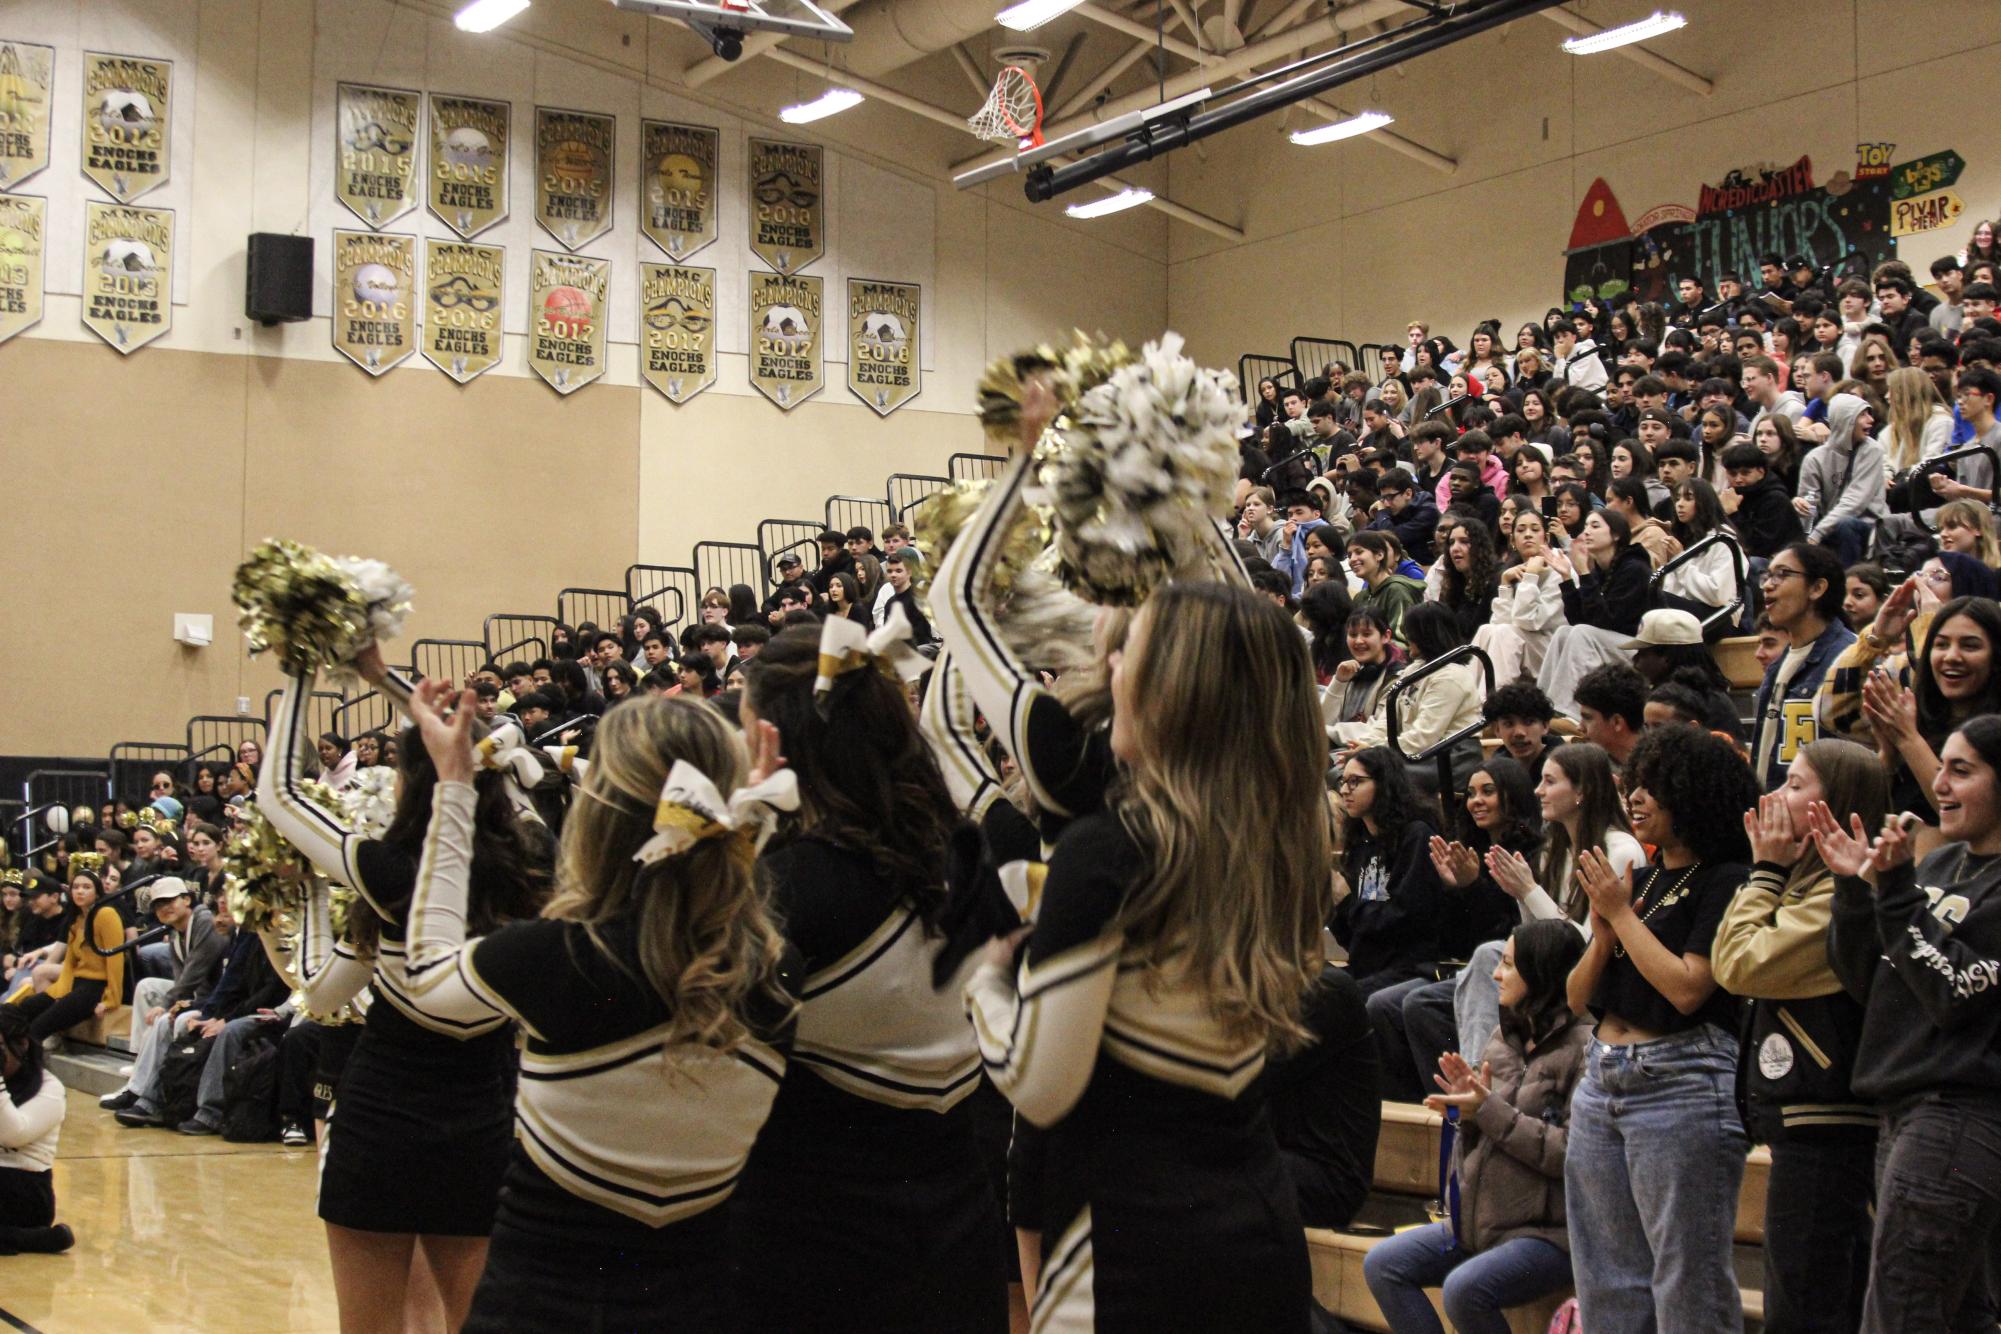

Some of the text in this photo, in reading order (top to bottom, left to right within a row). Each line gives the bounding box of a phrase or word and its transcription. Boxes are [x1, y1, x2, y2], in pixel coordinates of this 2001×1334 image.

[97, 60, 157, 75] MMC
[92, 145, 157, 162] ENOCHS
[764, 145, 807, 160] MMC
[1856, 143, 1896, 166] TOY
[88, 157, 160, 174] EAGLES
[343, 151, 411, 176] 2015
[1858, 167, 1889, 176] STORY
[352, 173, 401, 188] ENOCHS
[348, 184, 403, 200] EAGLES
[442, 182, 491, 198] ENOCHS
[439, 193, 494, 209] EAGLES
[549, 194, 596, 210] ENOCHS
[100, 209, 160, 222] MMC
[546, 205, 598, 222] EAGLES
[651, 217, 704, 233] EAGLES
[761, 223, 811, 238] ENOCHS
[347, 235, 403, 249] MMC
[758, 233, 814, 249] EAGLES
[437, 245, 493, 260] MMC
[337, 244, 413, 278] CHAMPIONS
[429, 254, 501, 288] CHAMPIONS
[656, 268, 702, 282] MMC
[98, 273, 158, 298] 2013
[534, 266, 606, 302] CHAMPIONS
[765, 278, 808, 290] MMC
[863, 284, 906, 298] MMC
[643, 277, 712, 309] CHAMPIONS
[93, 295, 159, 312] ENOCHS
[343, 299, 407, 320] 2016
[752, 286, 819, 318] CHAMPIONS
[851, 293, 917, 324] CHAMPIONS
[89, 307, 162, 324] EAGLES
[433, 307, 494, 330] 2016
[349, 320, 400, 334] ENOCHS
[439, 327, 487, 343] ENOCHS
[537, 319, 595, 343] 2017
[346, 331, 403, 346] EAGLES
[538, 338, 593, 354] ENOCHS
[649, 330, 705, 352] 2017
[434, 339, 489, 355] EAGLES
[759, 337, 812, 358] 2017
[857, 342, 911, 363] 2018
[536, 349, 595, 366] EAGLES
[651, 349, 704, 363] ENOCHS
[760, 356, 811, 370] ENOCHS
[649, 361, 706, 374] EAGLES
[758, 367, 814, 381] EAGLES
[858, 362, 908, 377] ENOCHS
[856, 373, 911, 387] EAGLES
